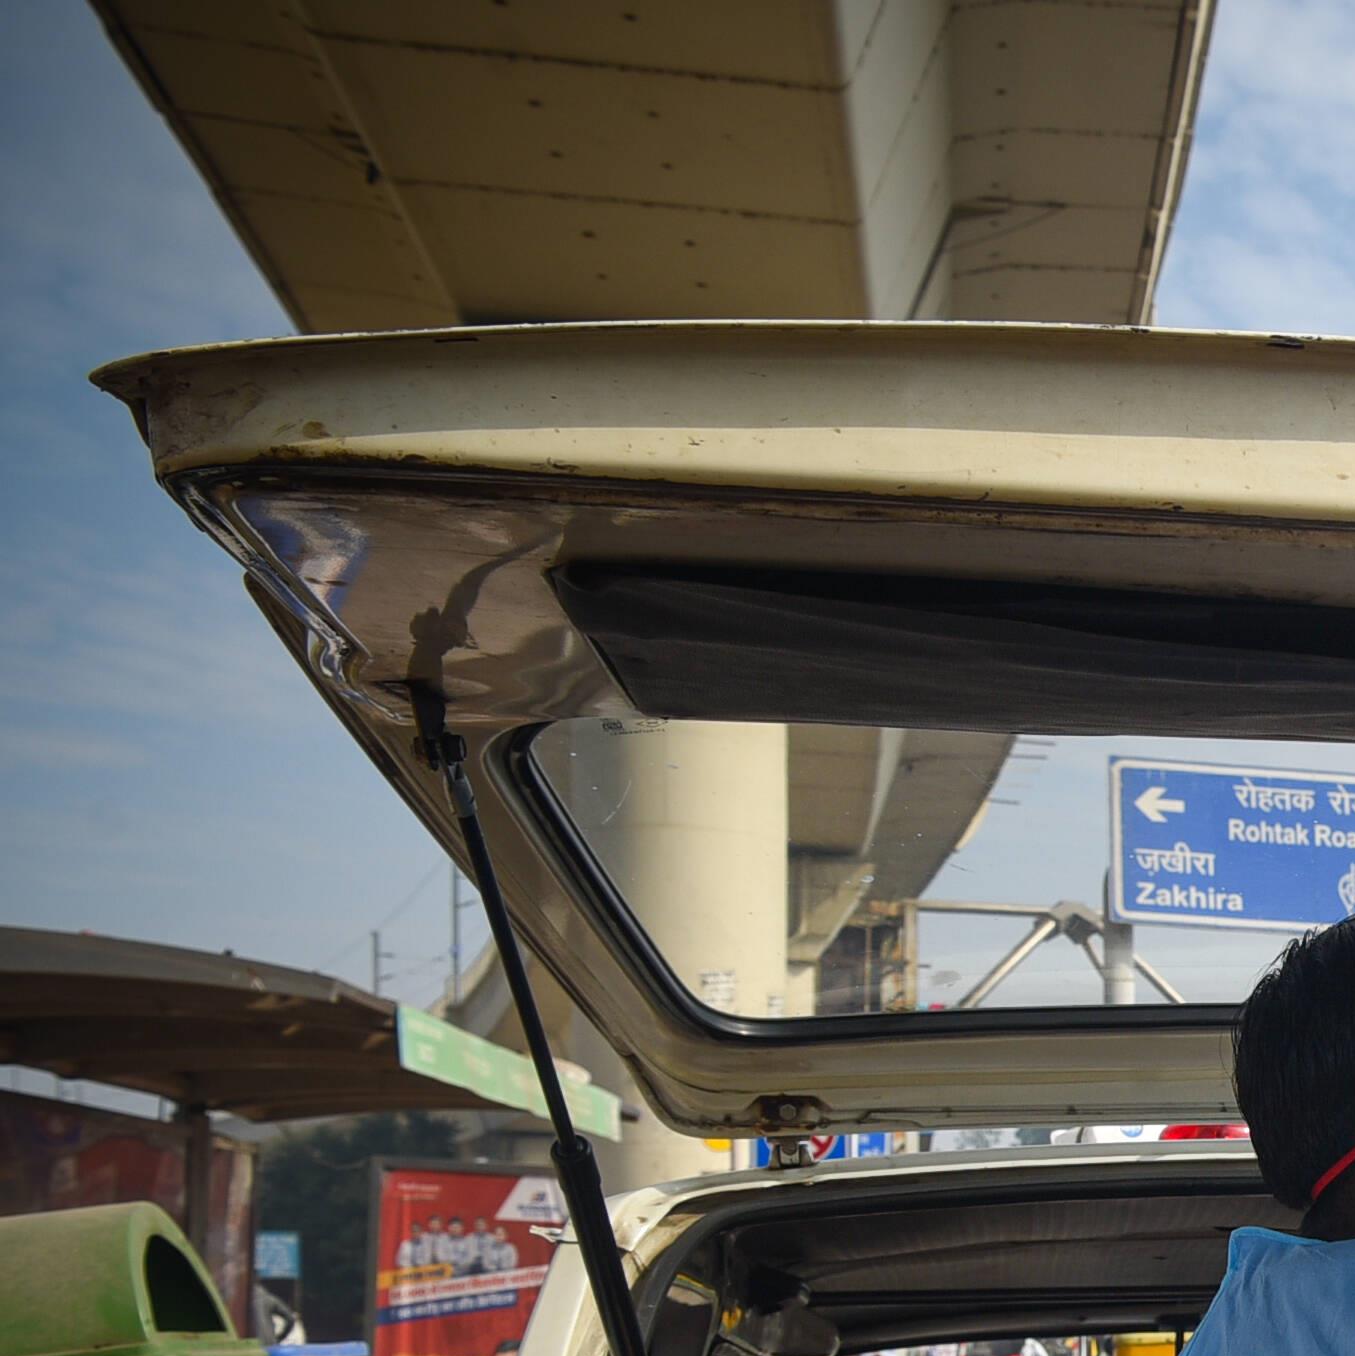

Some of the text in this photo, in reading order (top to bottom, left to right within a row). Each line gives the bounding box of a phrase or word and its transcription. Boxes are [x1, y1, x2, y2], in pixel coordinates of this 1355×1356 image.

[1232, 777, 1316, 813] रोहतक
[1228, 817, 1311, 847] Rohtak
[1135, 881, 1244, 912] Zakhira
